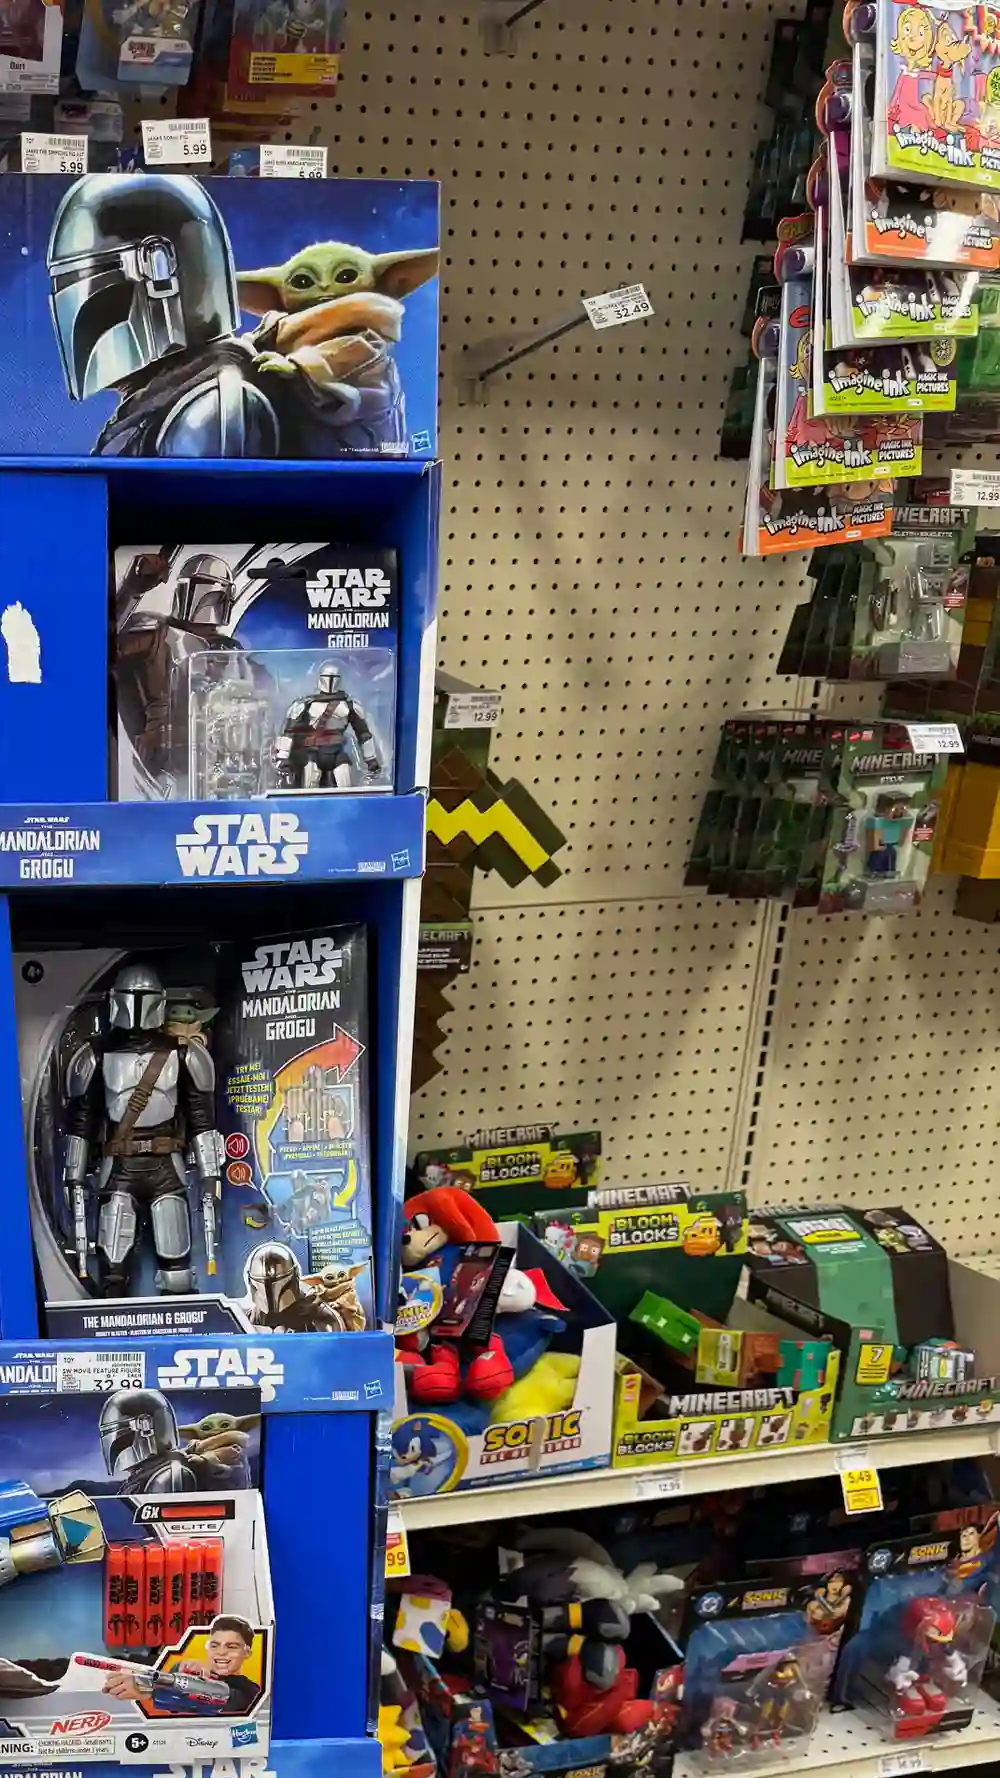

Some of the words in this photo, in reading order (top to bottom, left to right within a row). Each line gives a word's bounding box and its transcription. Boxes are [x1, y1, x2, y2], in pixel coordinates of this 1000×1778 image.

[183, 143, 208, 157] 5.99
[59, 161, 84, 174] 5.99
[614, 302, 651, 321] 32.49
[306, 568, 391, 590] STAR
[306, 586, 391, 610] WARS
[307, 611, 390, 631] MANDALORIAN
[327, 633, 371, 649] GROGU
[850, 750, 940, 773] MINECRAFT
[175, 813, 309, 847] STAR
[19, 857, 75, 880] GROGU
[176, 844, 309, 877] WARS
[241, 936, 343, 973] STAR
[242, 959, 343, 994] WARS
[241, 989, 341, 1020] MANDALORIAN
[265, 1017, 316, 1041] GROGU
[587, 1182, 692, 1208] MINECRAFT
[613, 1211, 676, 1231] BLOOM
[609, 1226, 679, 1247] BLOCKS
[82, 1314, 100, 1330] THE
[101, 1313, 163, 1329] MANDALORIAN
[164, 1313, 173, 1328] &
[174, 1311, 206, 1328] GROGU
[156, 1348, 285, 1384] STAR
[668, 1386, 800, 1415] MINECRAFT
[139, 1504, 161, 1520] 6X
[169, 1521, 219, 1532] ELITE
[50, 1710, 112, 1736] NERF
